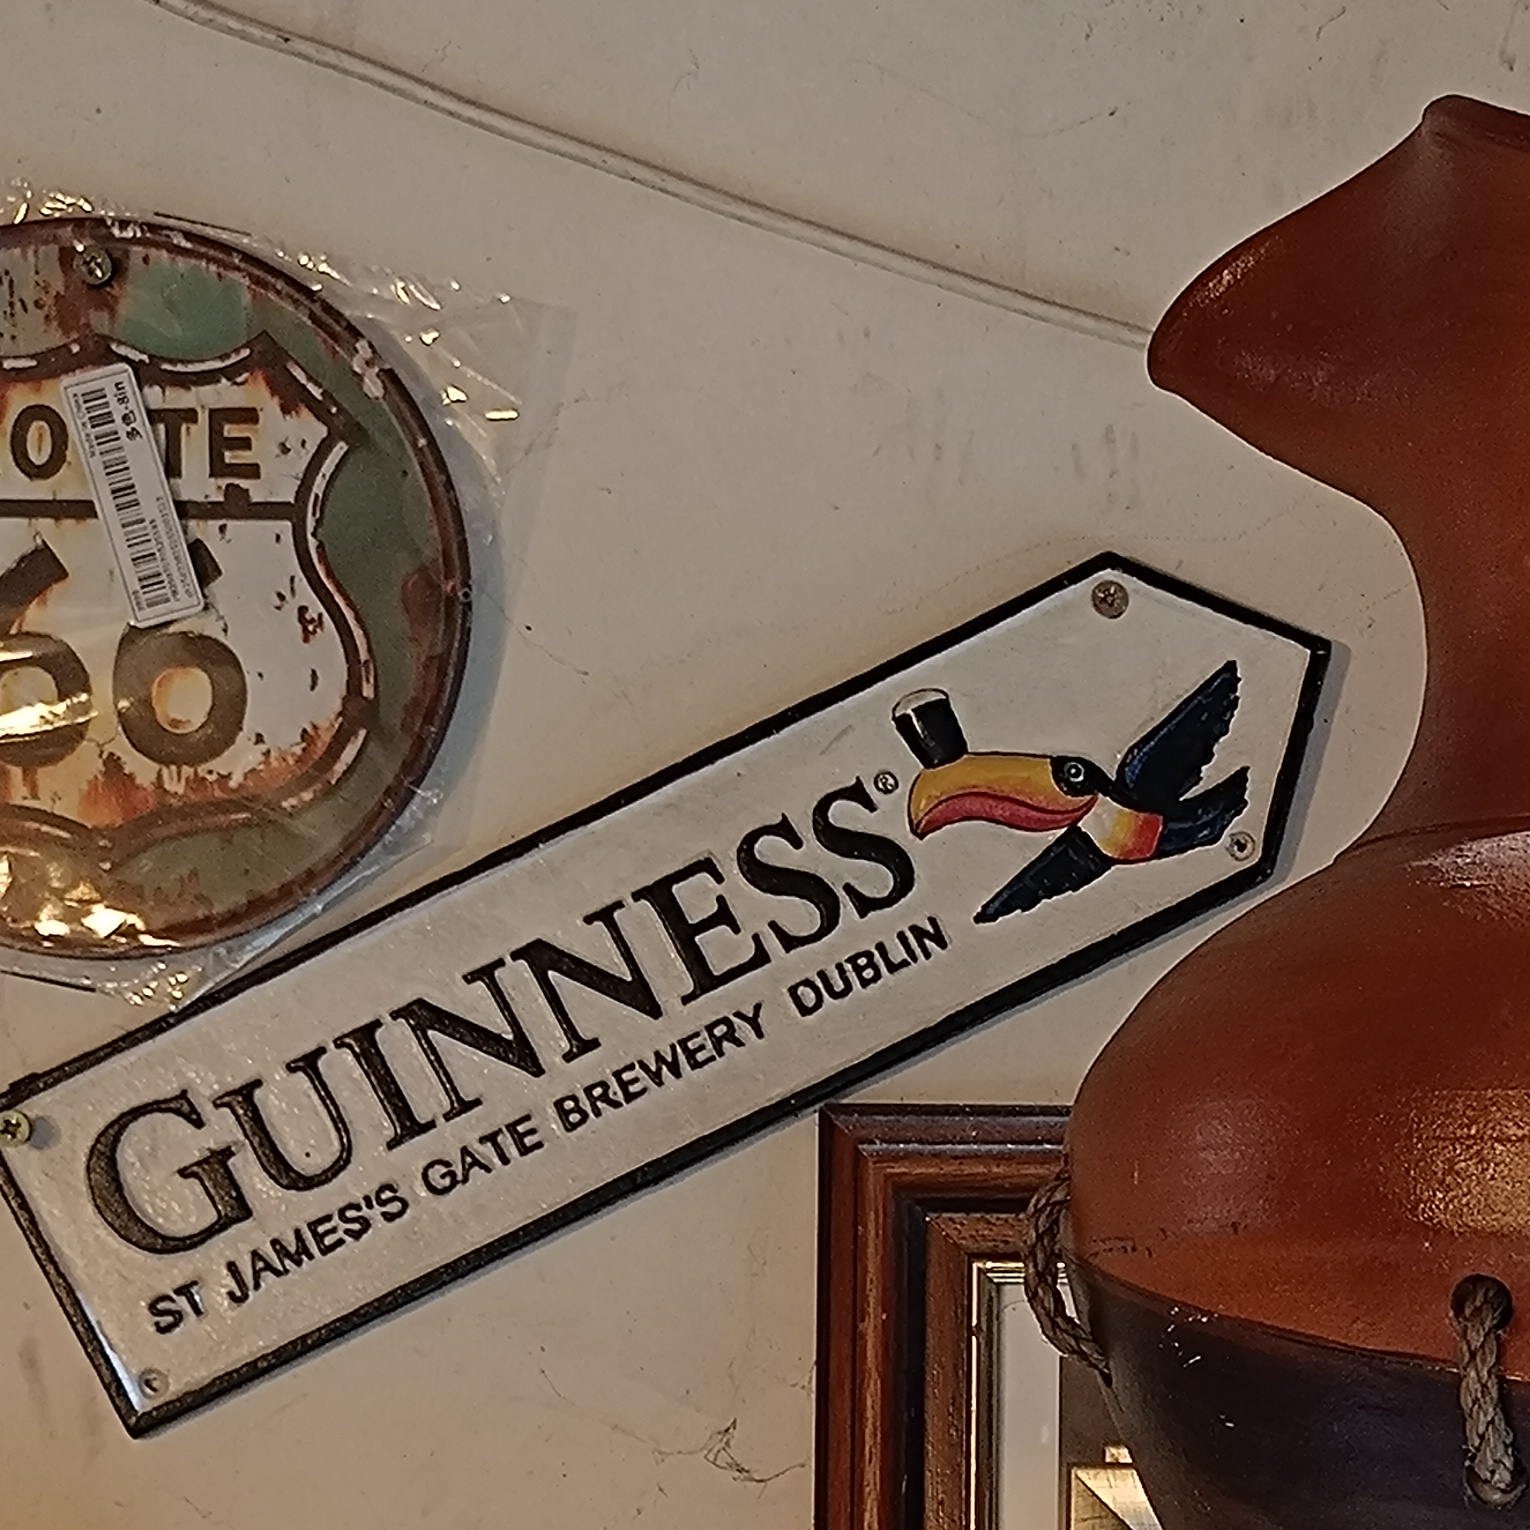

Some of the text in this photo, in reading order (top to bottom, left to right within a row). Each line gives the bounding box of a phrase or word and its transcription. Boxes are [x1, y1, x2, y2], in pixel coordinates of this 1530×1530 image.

[148, 917, 951, 1336] ST JAMES'S GATE BREWERY DUBLIN
